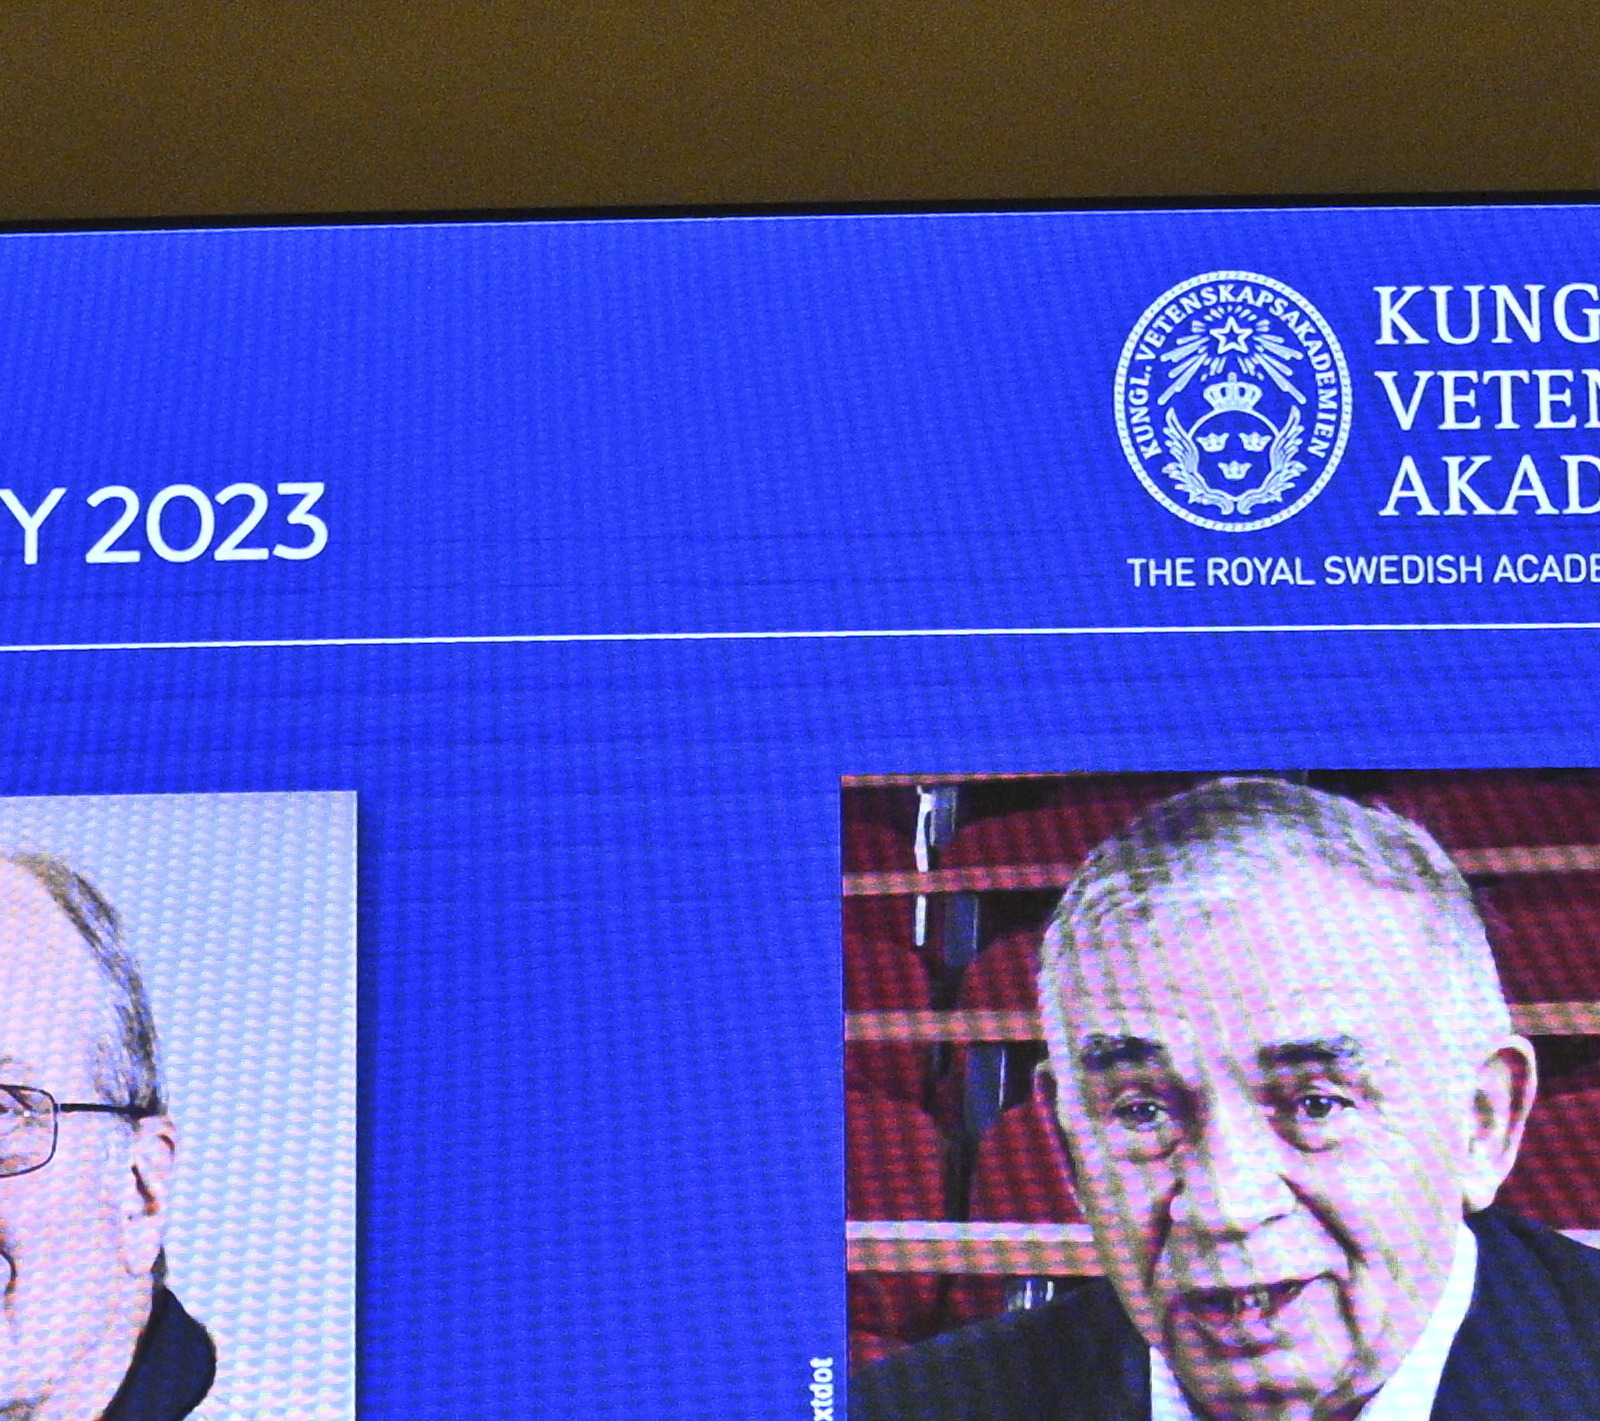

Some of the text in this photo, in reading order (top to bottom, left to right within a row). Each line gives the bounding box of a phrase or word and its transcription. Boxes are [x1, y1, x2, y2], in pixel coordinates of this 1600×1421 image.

[1135, 284, 1338, 459] VETENSKAPSAKADEMIEN
[86, 483, 327, 563] 2023
[1127, 558, 1195, 586] THE
[1208, 557, 1315, 585] ROYAL
[1325, 555, 1482, 584] SWEDISH
